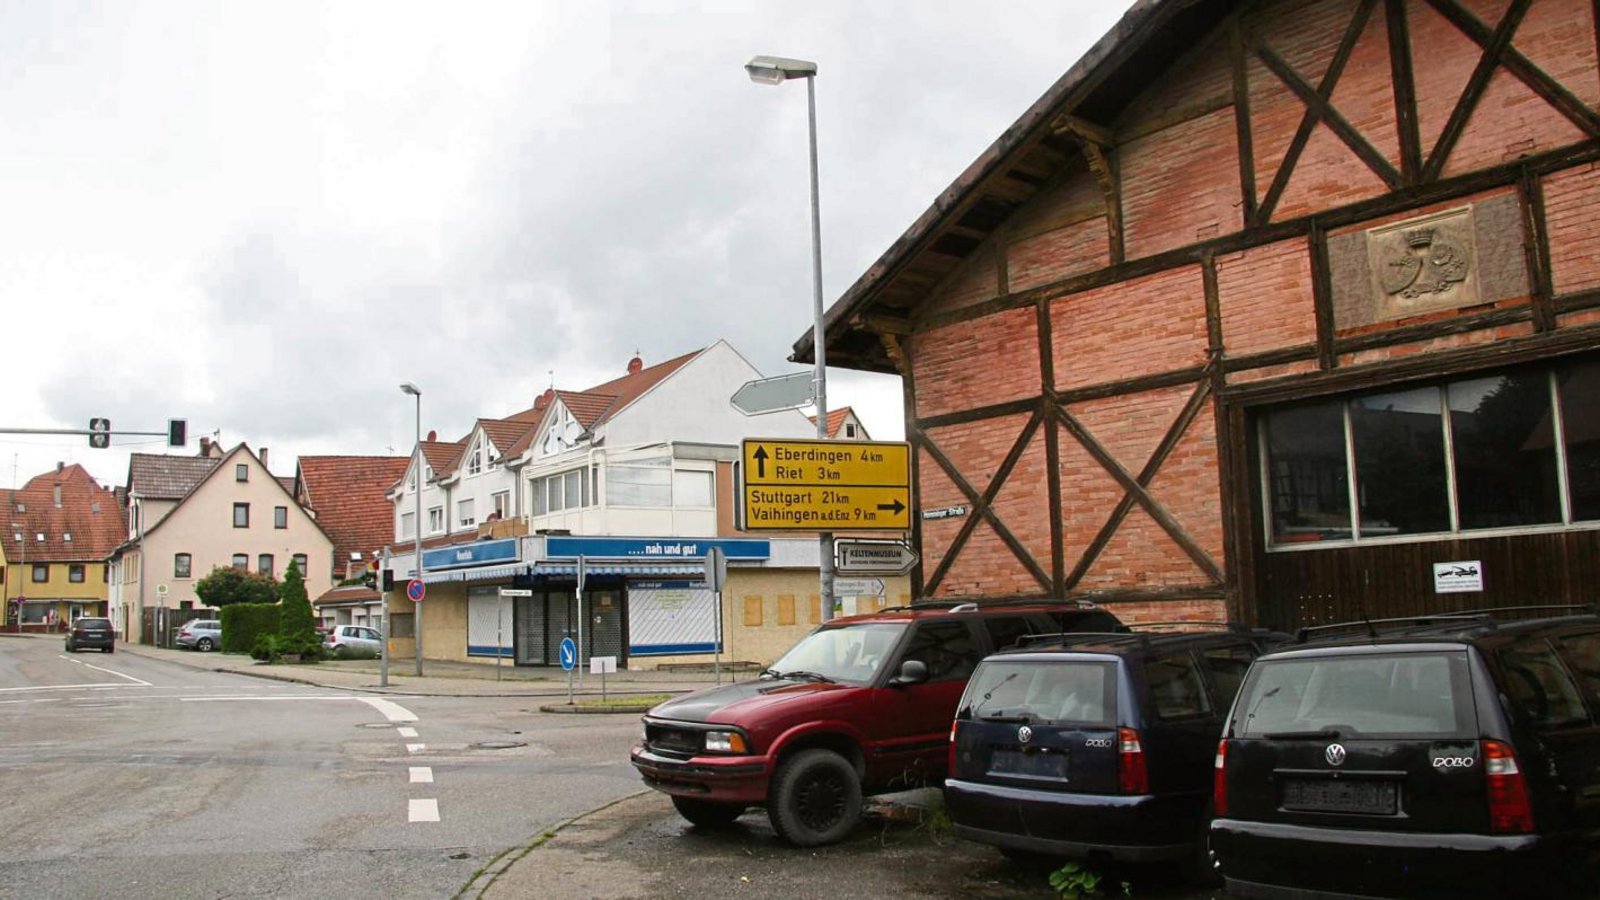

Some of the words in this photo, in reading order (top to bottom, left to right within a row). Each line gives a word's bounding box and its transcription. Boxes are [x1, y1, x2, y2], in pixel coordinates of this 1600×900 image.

[775, 447, 852, 465] Eberdingen
[861, 449, 868, 462] 4
[870, 451, 883, 462] km
[776, 466, 803, 479] Riet
[751, 490, 812, 506] Stuttgart
[752, 507, 818, 524] Vaihingen
[854, 508, 861, 521] 9
[863, 510, 876, 521] km
[664, 542, 681, 555] und
[682, 543, 697, 556] gut
[850, 549, 902, 558] KELTENMUSEUM
[1432, 757, 1474, 768] POLO
